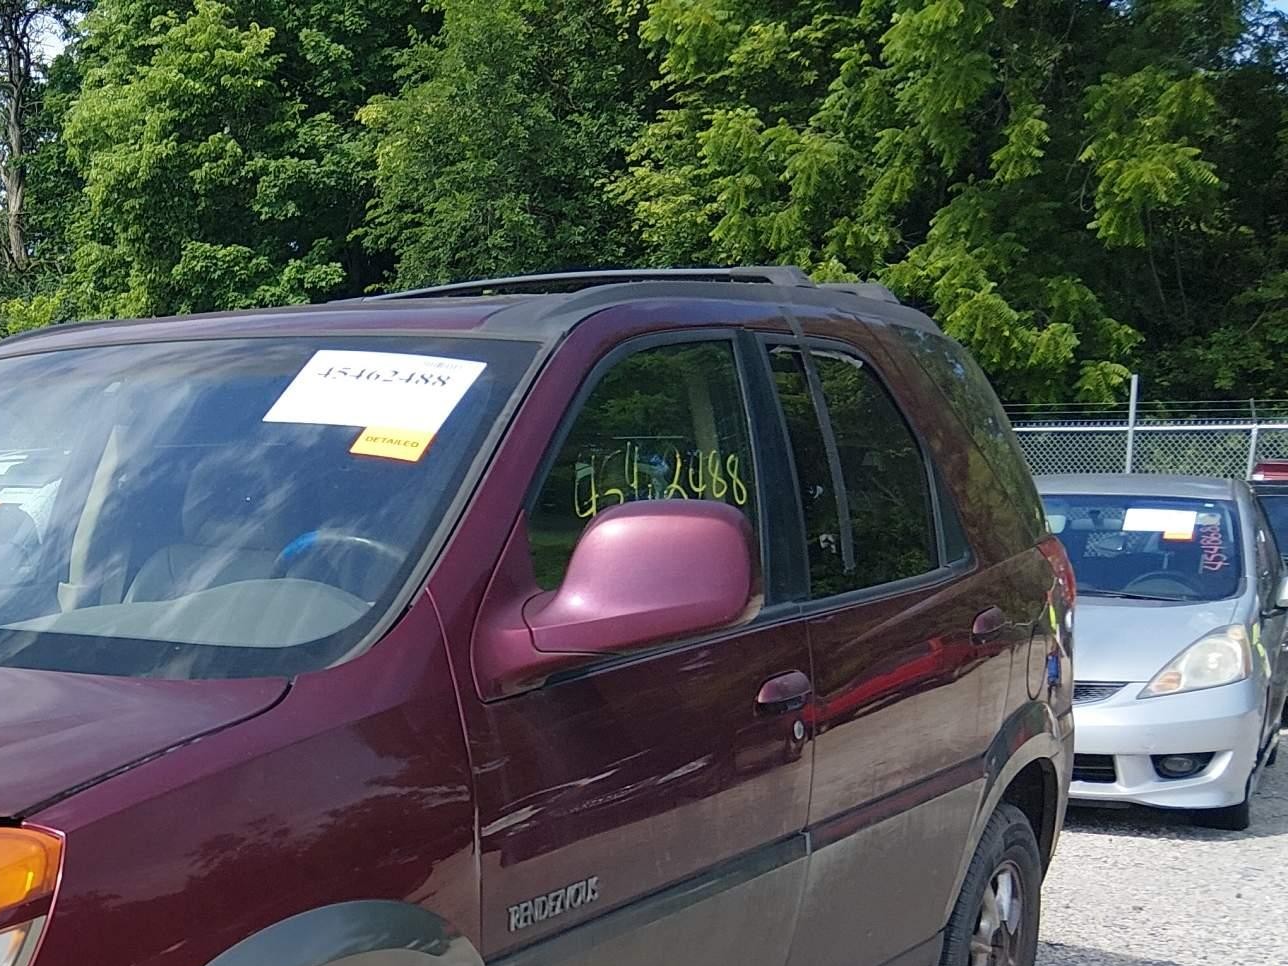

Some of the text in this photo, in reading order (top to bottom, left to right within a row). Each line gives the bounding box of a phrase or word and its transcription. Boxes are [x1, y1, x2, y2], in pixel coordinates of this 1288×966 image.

[317, 366, 451, 388] 45462488
[364, 435, 420, 450] DETAILED
[508, 876, 600, 932] RENDEZVOUS
